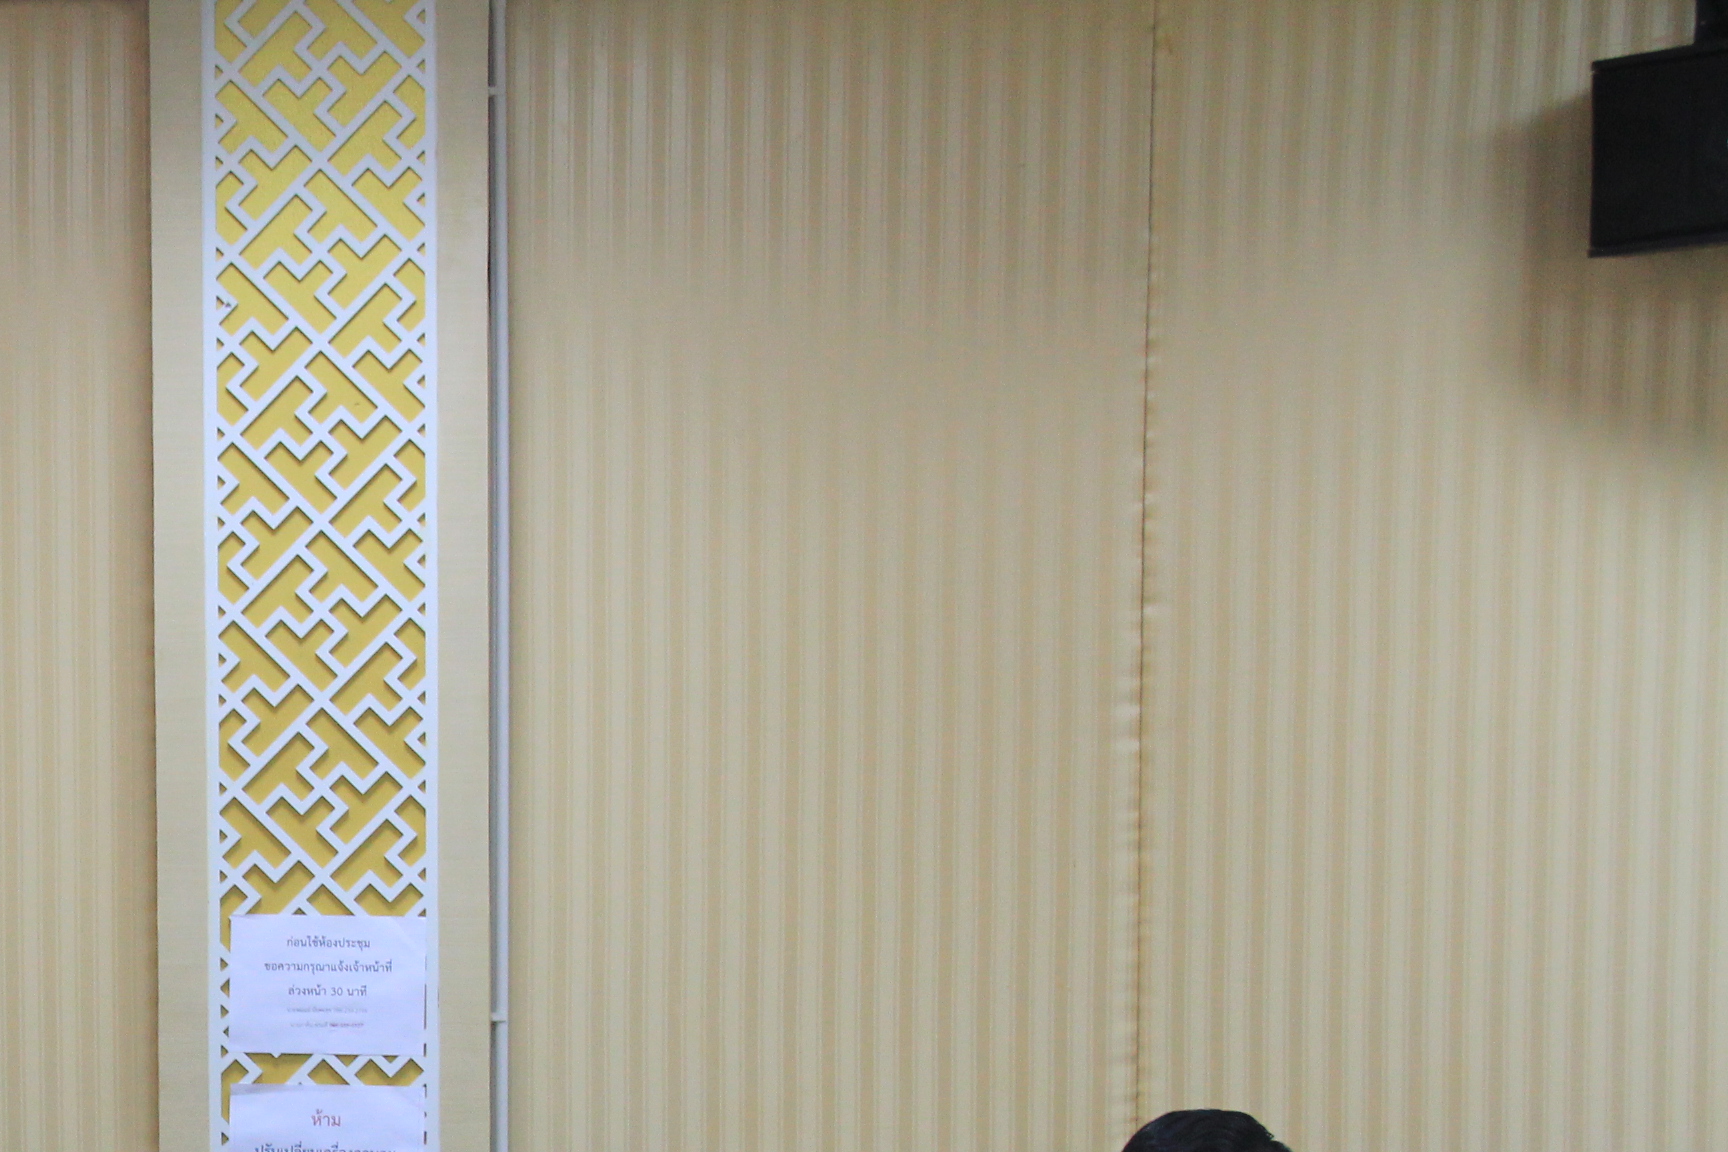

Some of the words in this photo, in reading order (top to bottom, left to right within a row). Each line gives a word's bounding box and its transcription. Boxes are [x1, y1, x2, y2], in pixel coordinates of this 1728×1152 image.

[286, 935, 371, 952] ก่อนใช้ห้องประชุม
[264, 959, 393, 976] ขอความกรุณาแจ้งเจ้าหน้าที่
[288, 984, 327, 997] ล่วงหน้า
[330, 986, 344, 997] 30
[346, 984, 368, 997] นาที
[311, 1108, 342, 1128] ห้าม
